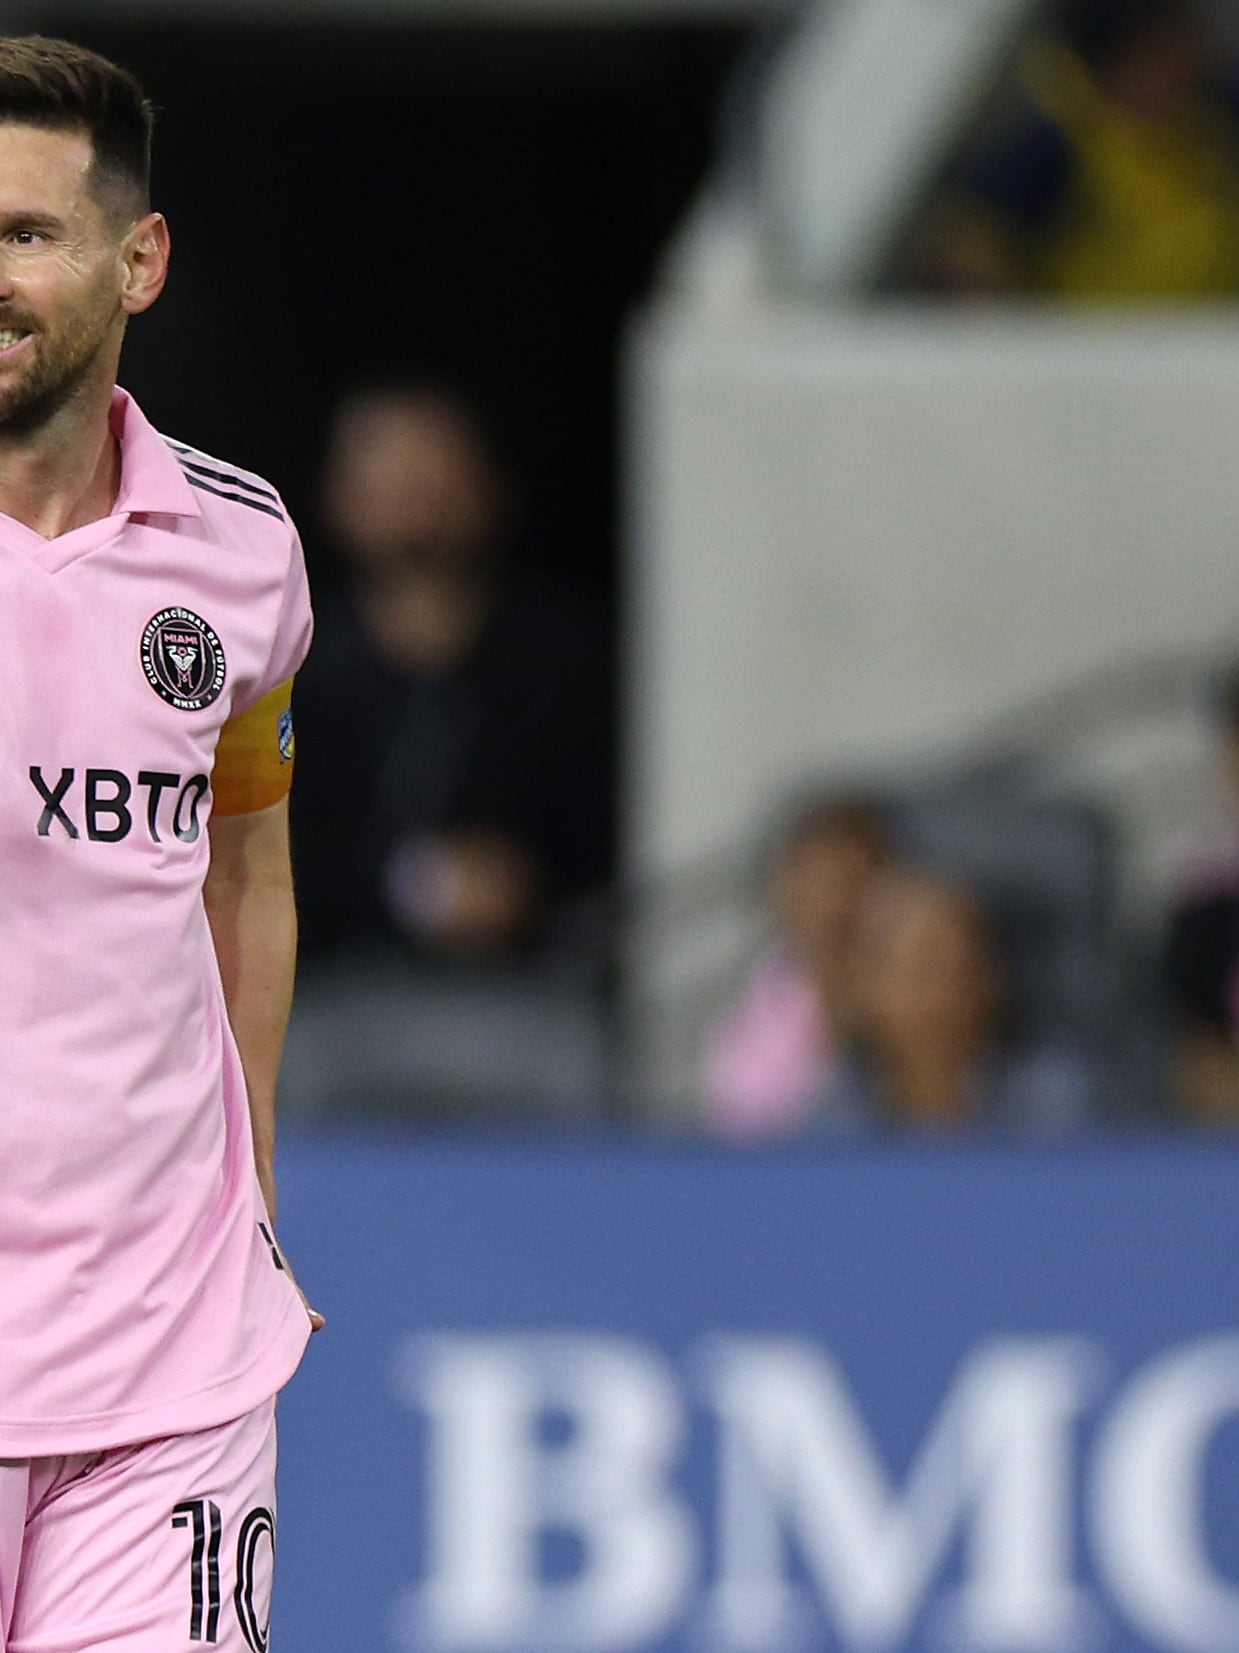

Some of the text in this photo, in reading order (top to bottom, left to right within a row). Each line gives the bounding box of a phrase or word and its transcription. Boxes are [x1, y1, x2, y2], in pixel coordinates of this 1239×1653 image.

[142, 607, 206, 650] INTERNACIONAL
[163, 633, 198, 645] MIAMI
[207, 631, 219, 646] DE
[142, 655, 158, 685] CLUB
[173, 697, 202, 709] MMXX
[29, 766, 210, 844] XBTO
[171, 1500, 275, 1653] 10
